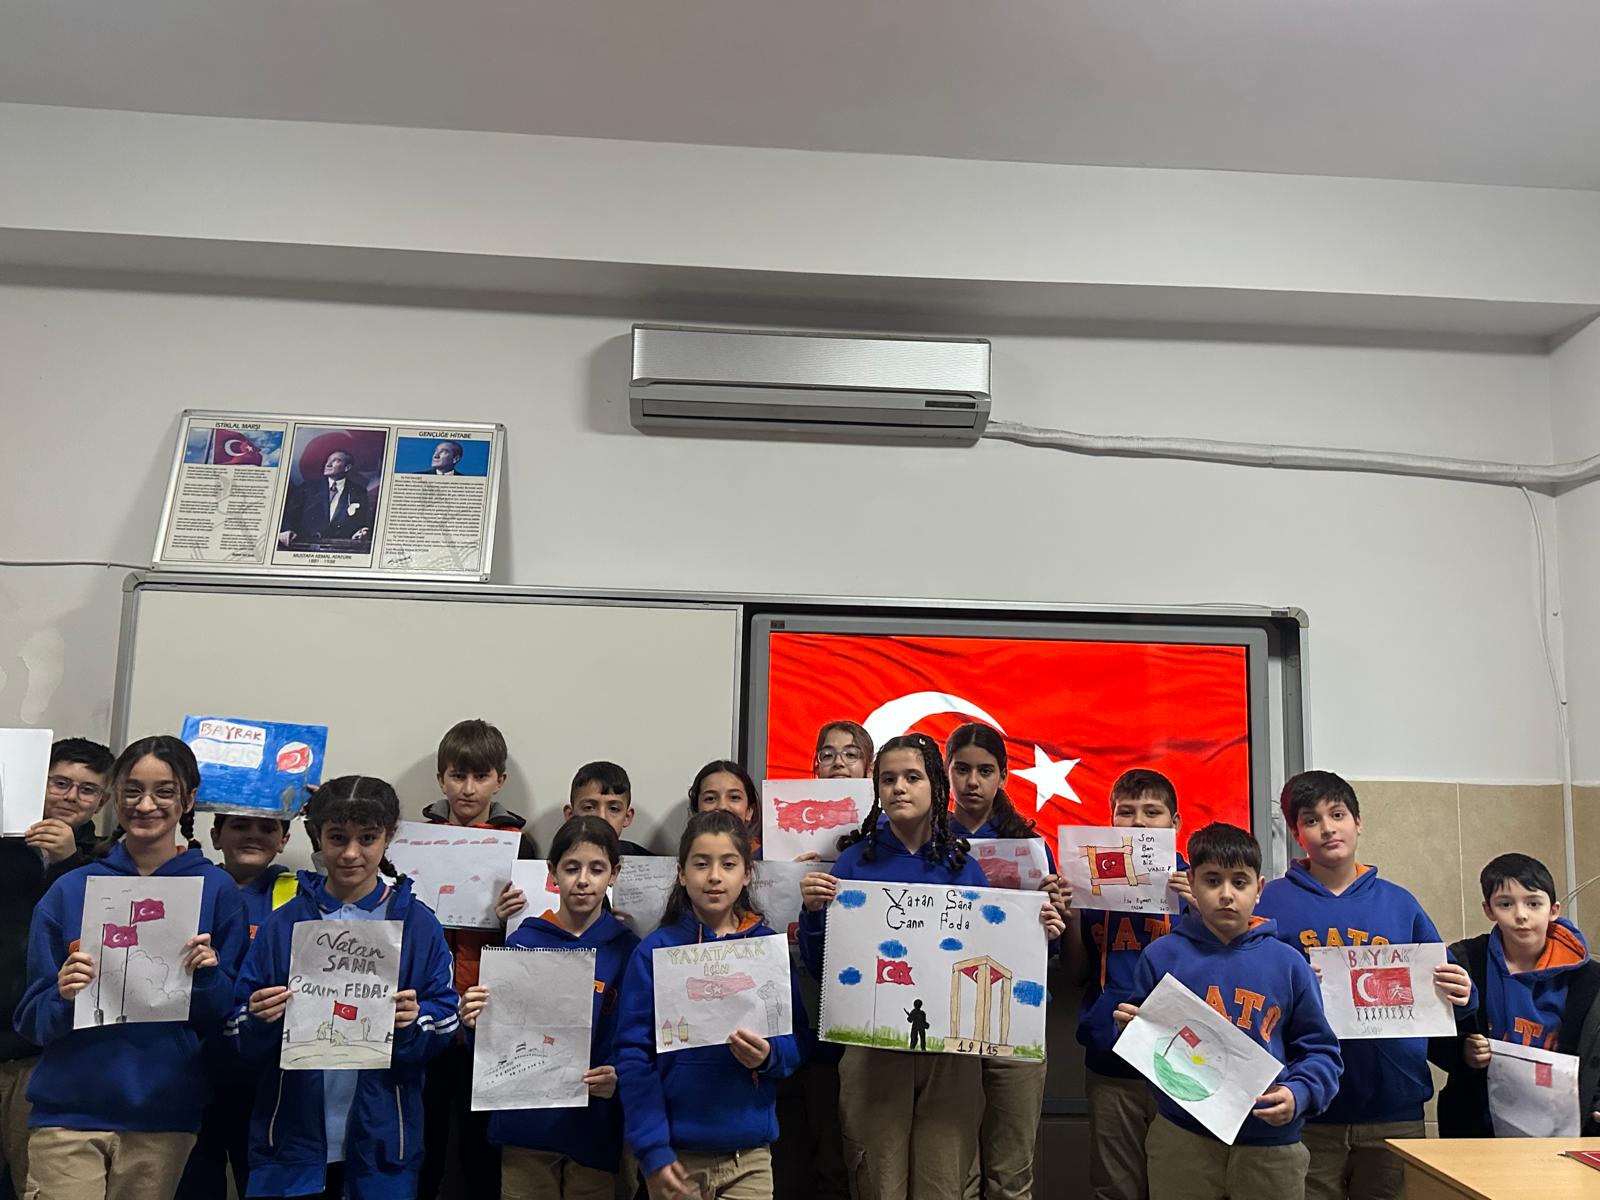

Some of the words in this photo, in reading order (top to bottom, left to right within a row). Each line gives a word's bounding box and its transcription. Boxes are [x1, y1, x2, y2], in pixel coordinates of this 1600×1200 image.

[201, 722, 262, 741] BAYRAK
[882, 888, 935, 908] Vatan
[945, 889, 972, 911] Sana
[940, 912, 970, 930] Feda
[316, 931, 385, 959] Vatan
[322, 955, 377, 975] SANA
[345, 983, 390, 999] FEDA!
[1205, 985, 1281, 1042] ATO
